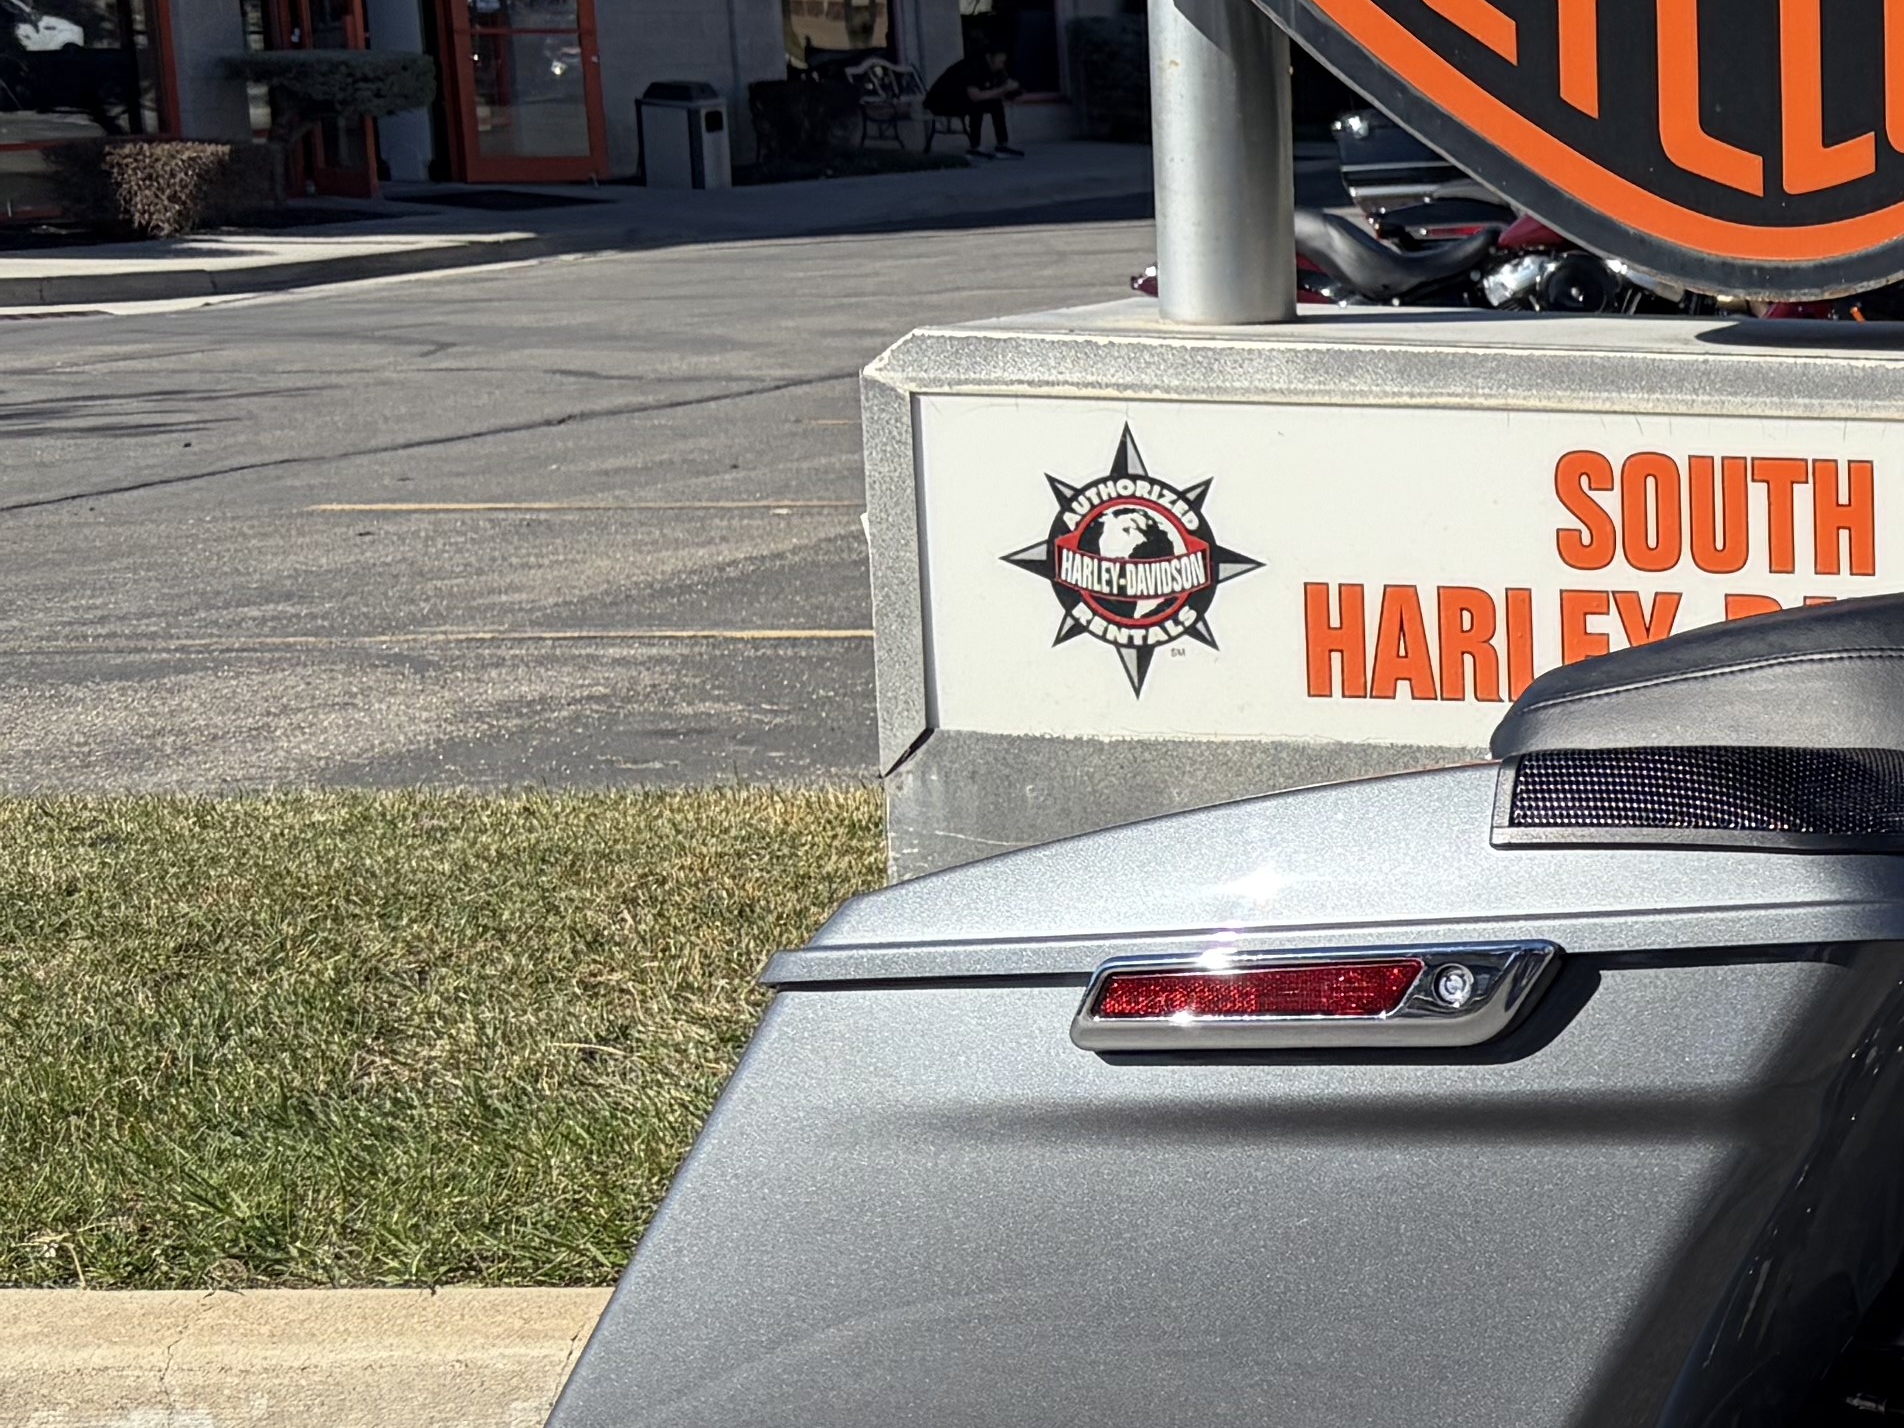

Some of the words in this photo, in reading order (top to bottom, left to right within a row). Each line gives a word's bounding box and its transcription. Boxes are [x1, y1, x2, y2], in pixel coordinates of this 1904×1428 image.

[1062, 478, 1200, 532] AUTHORIZED
[1554, 449, 1876, 576] SOUTH
[1060, 548, 1206, 596] HARLEY-DAVIDSON
[1071, 601, 1198, 646] RENTALS
